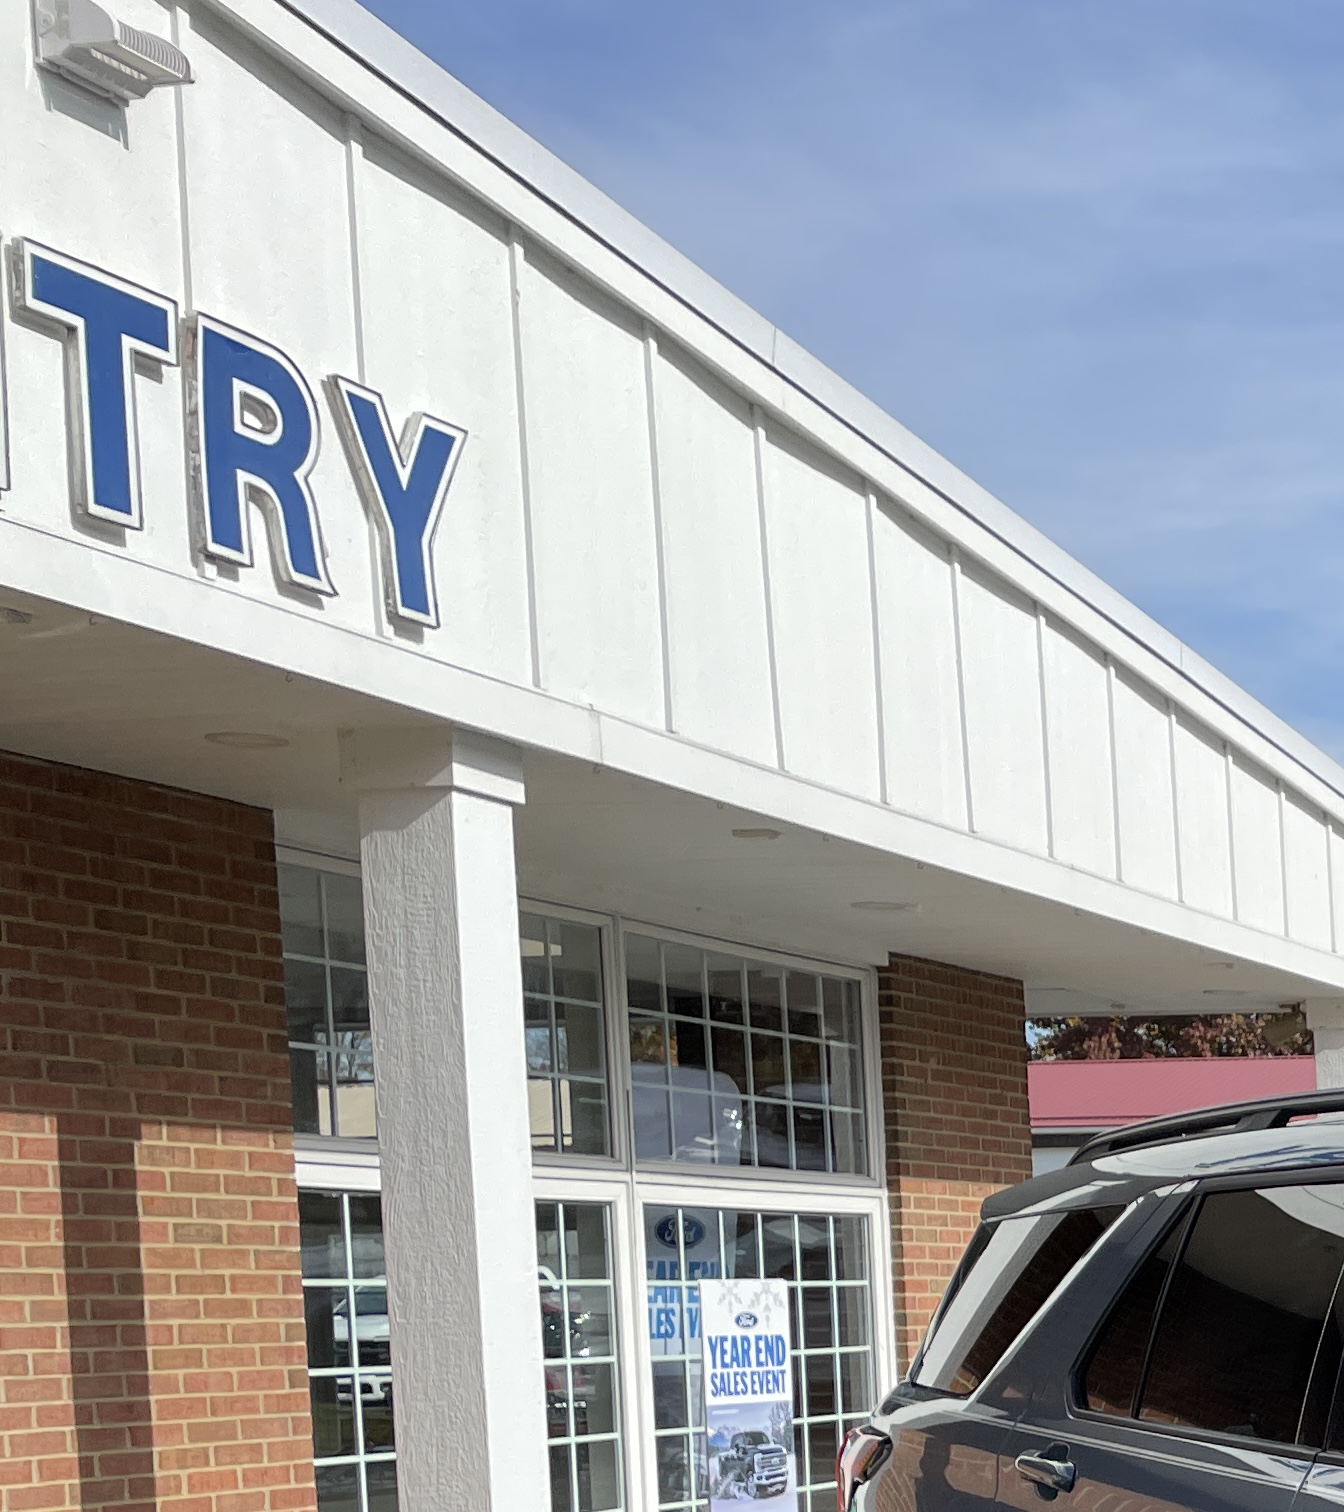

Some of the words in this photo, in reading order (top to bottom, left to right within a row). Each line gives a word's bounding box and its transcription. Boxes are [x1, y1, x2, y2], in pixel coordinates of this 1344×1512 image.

[707, 1335, 752, 1369] YEAR
[754, 1334, 787, 1368] END
[710, 1371, 749, 1398] SALES
[751, 1369, 787, 1396] EVENT
